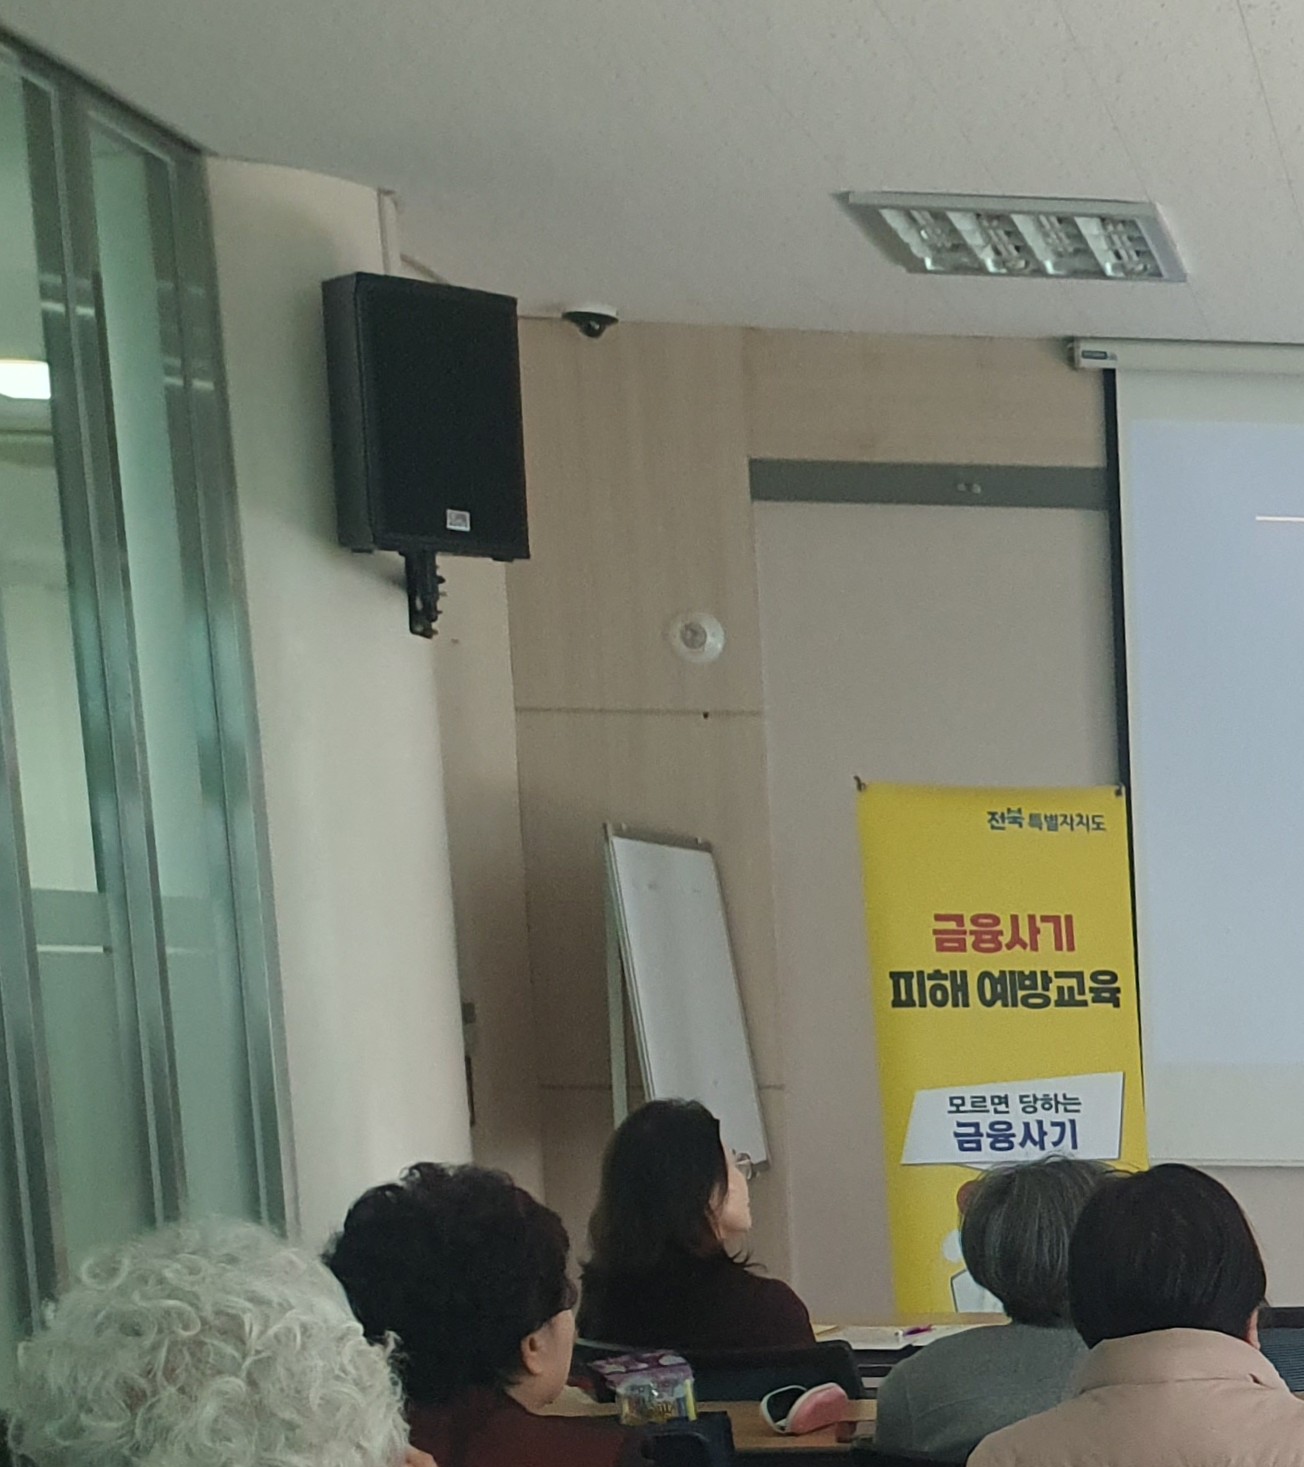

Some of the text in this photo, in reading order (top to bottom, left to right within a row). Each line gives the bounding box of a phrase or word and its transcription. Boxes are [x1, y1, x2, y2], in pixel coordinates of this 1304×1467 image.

[932, 912, 1076, 954] 금융사기
[889, 969, 1122, 1010] 피해 예방교육
[947, 1091, 1082, 1116] 모르면 당하는
[952, 1118, 1080, 1153] 금융사기
